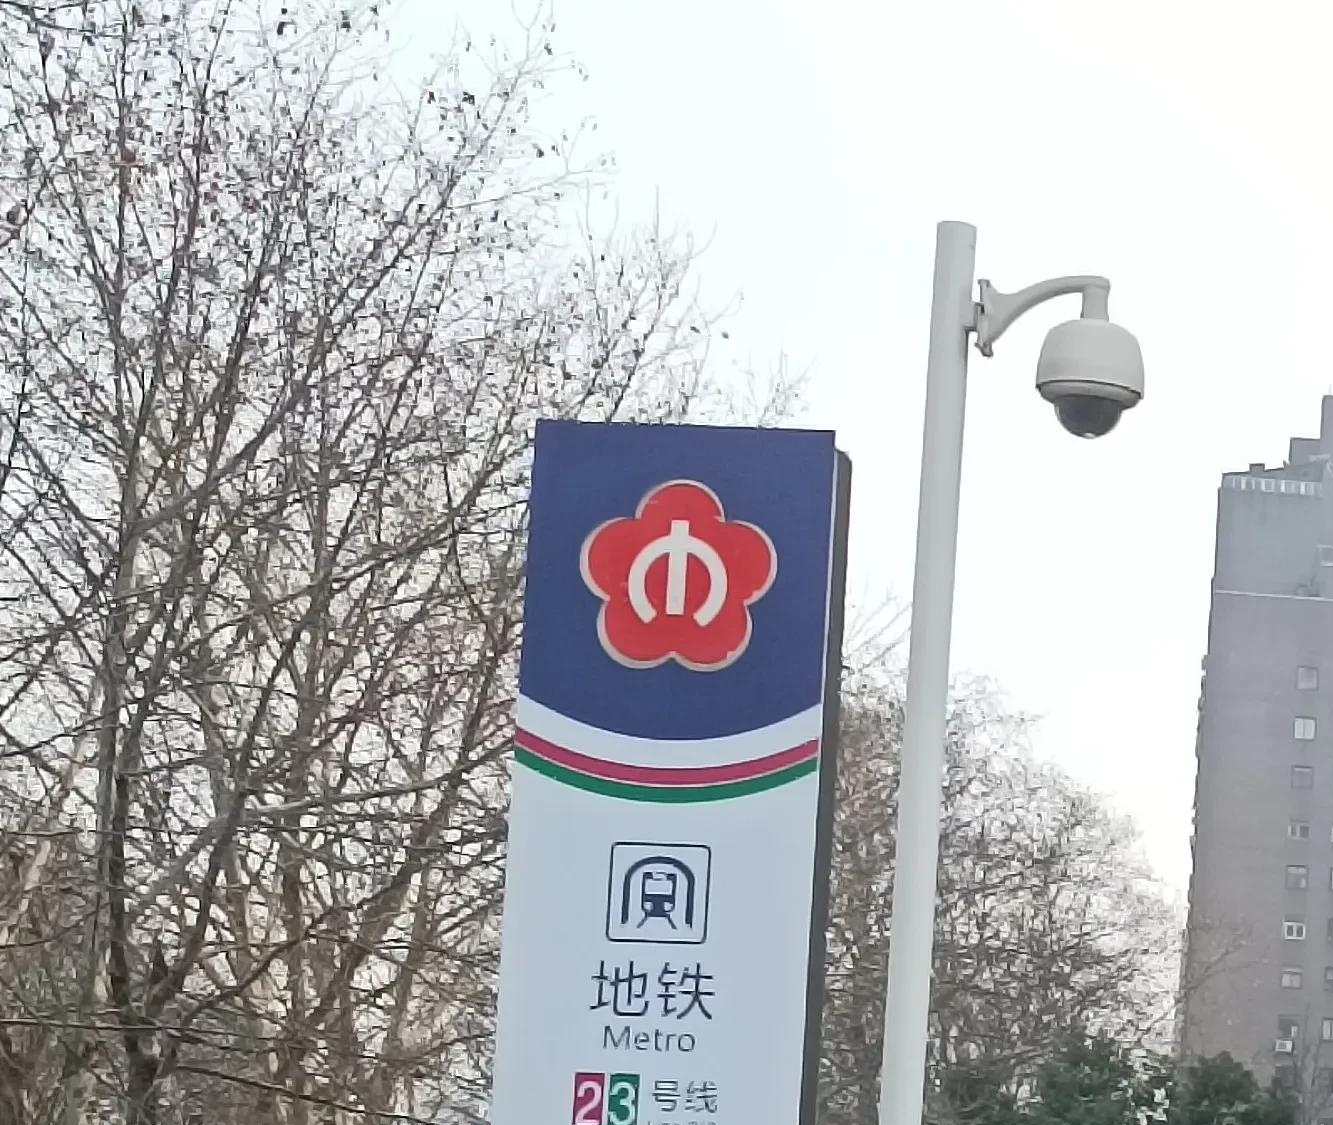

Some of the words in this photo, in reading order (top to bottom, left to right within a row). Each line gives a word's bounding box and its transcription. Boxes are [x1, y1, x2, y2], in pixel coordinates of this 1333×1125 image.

[589, 960, 715, 1020] 地铁
[603, 1025, 696, 1053] Metro
[652, 1080, 718, 1114] 号线
